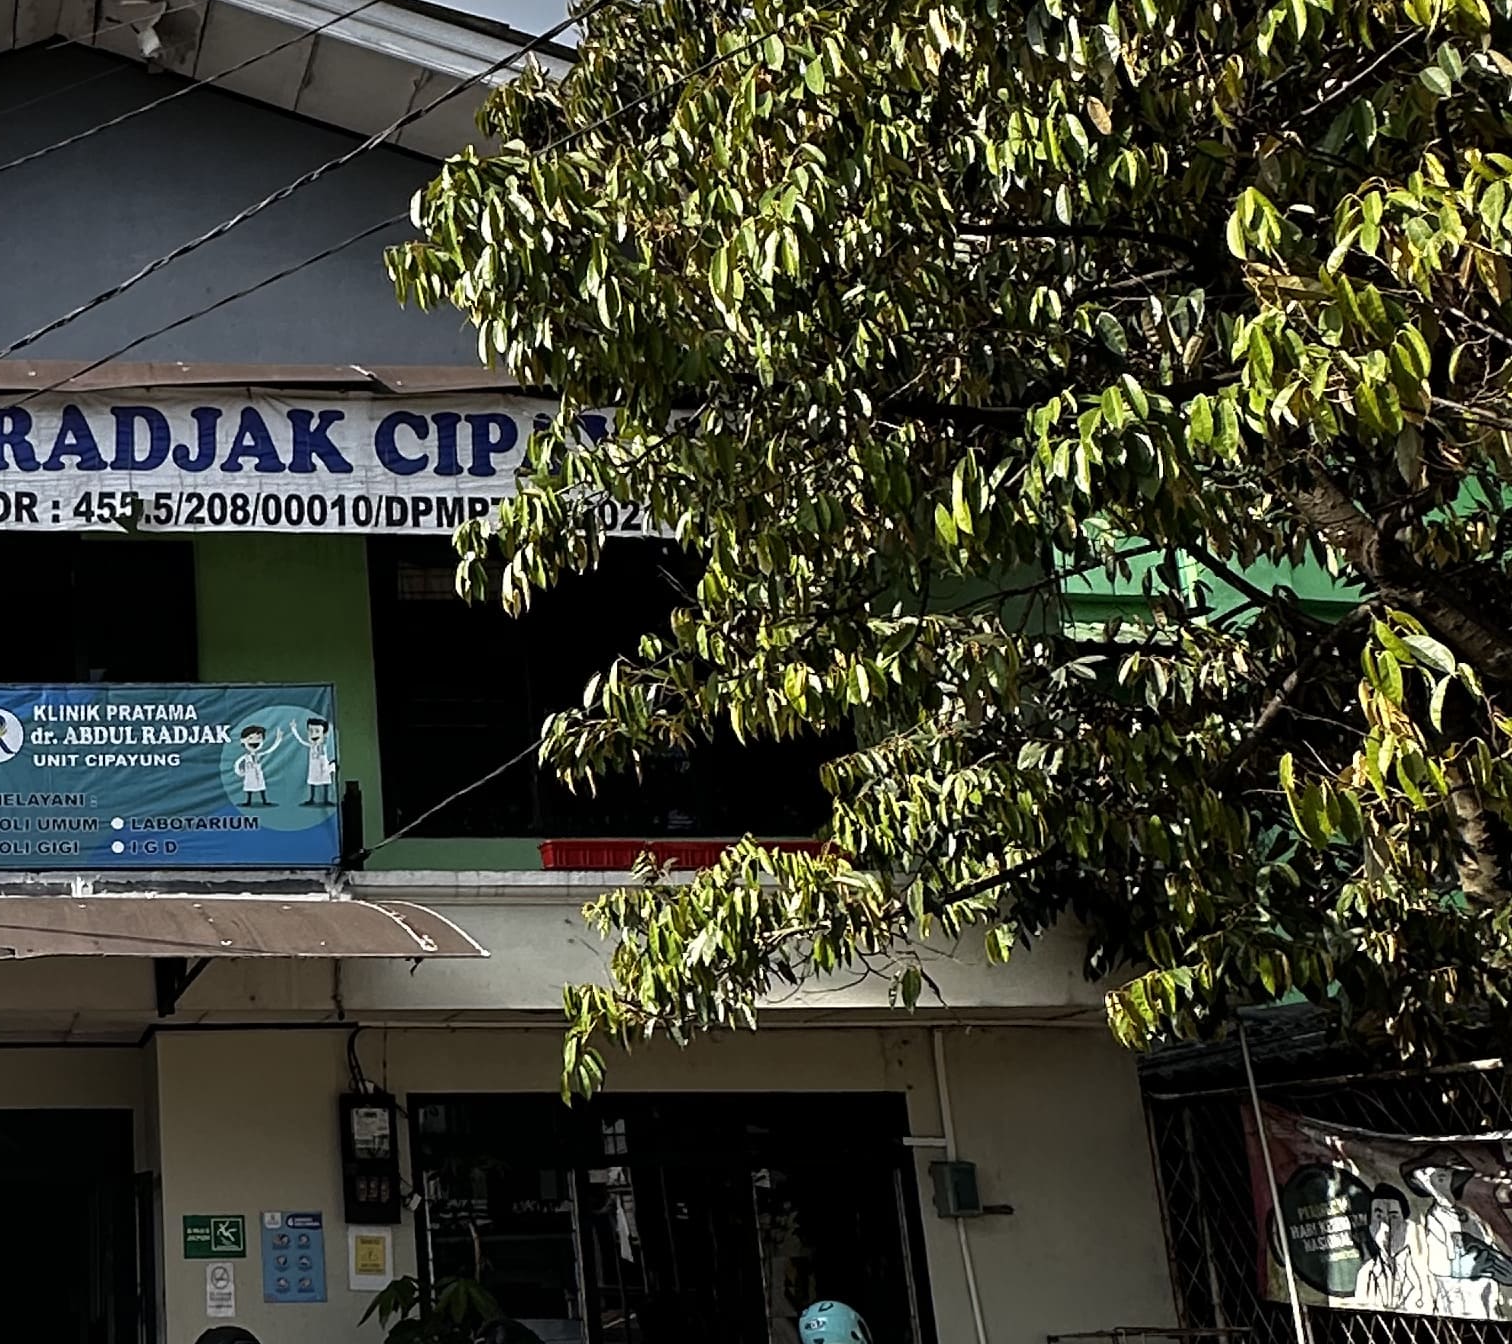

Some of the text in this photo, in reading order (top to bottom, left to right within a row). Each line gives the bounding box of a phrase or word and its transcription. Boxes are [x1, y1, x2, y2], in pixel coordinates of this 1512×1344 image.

[33, 704, 198, 722] KLINIK PRATAMA
[30, 724, 232, 745] dr. ABDUL RADJAK
[33, 753, 181, 768] UNIT CIPAYUNG
[37, 816, 100, 832] UMUM
[131, 815, 260, 832] LABOTARIUM
[36, 840, 80, 855] GIGI
